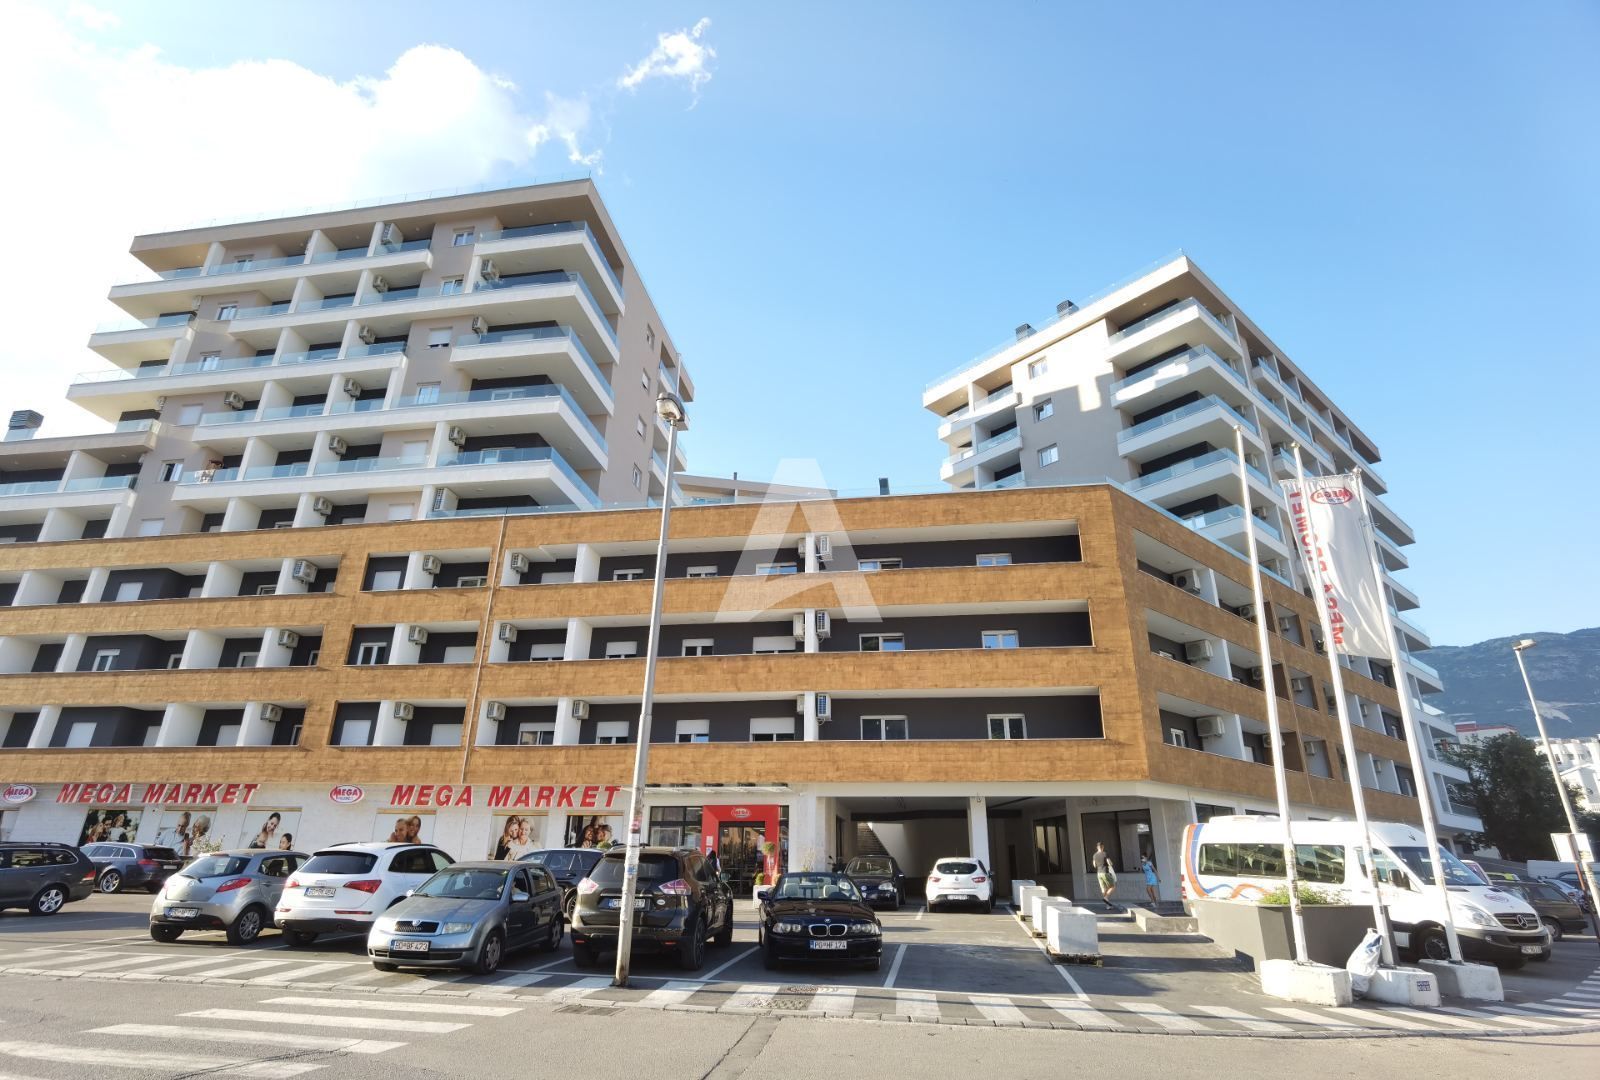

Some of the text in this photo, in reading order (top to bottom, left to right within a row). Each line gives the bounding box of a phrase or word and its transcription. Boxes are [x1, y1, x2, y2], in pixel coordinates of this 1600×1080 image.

[6, 787, 29, 796] MEGA
[56, 783, 260, 804] MEGA MARKET
[333, 786, 358, 796] MEGA
[390, 784, 621, 808] MEGA MARKET
